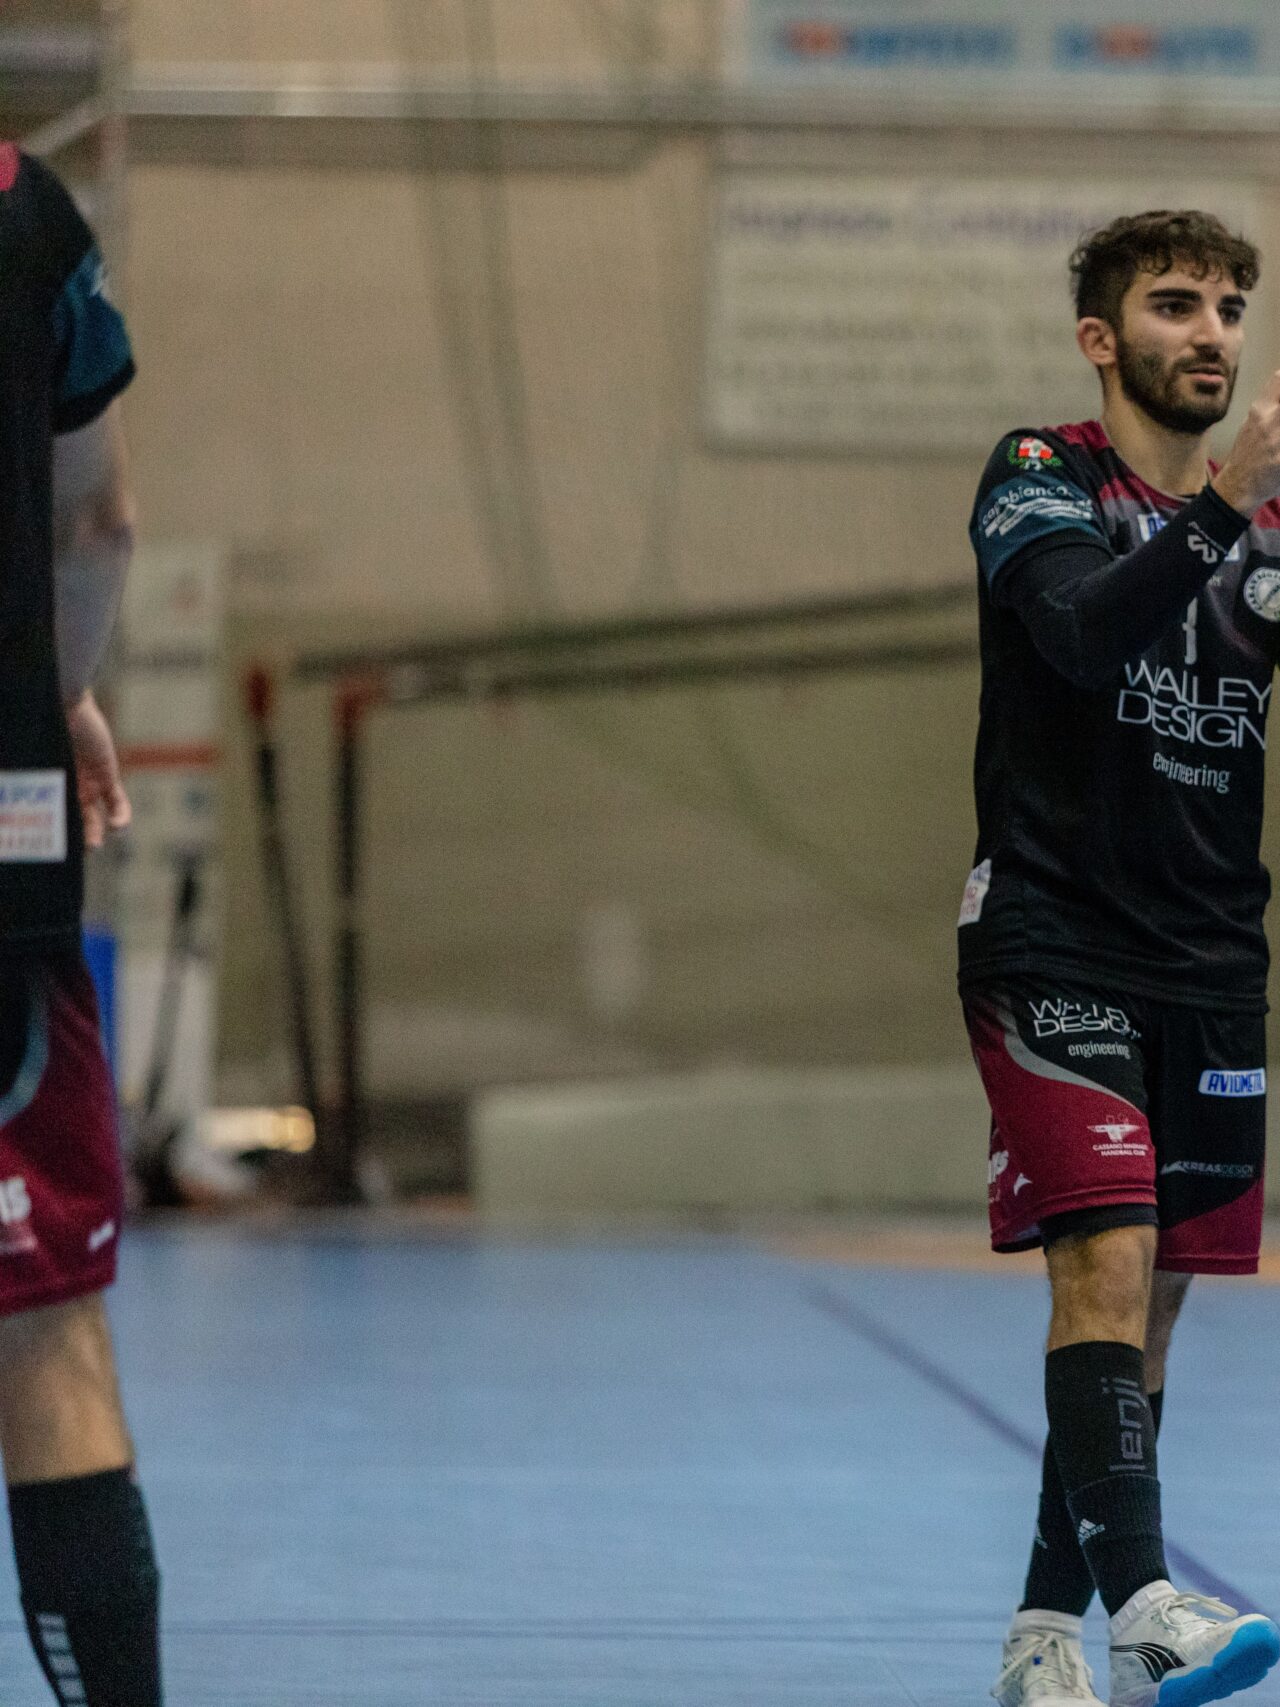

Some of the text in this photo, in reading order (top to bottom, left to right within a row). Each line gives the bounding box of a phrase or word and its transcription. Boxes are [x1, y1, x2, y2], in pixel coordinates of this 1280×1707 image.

[1125, 659, 1273, 714] WALLEY
[1117, 688, 1267, 750] DESIGN
[1068, 1041, 1131, 1060] engineering
